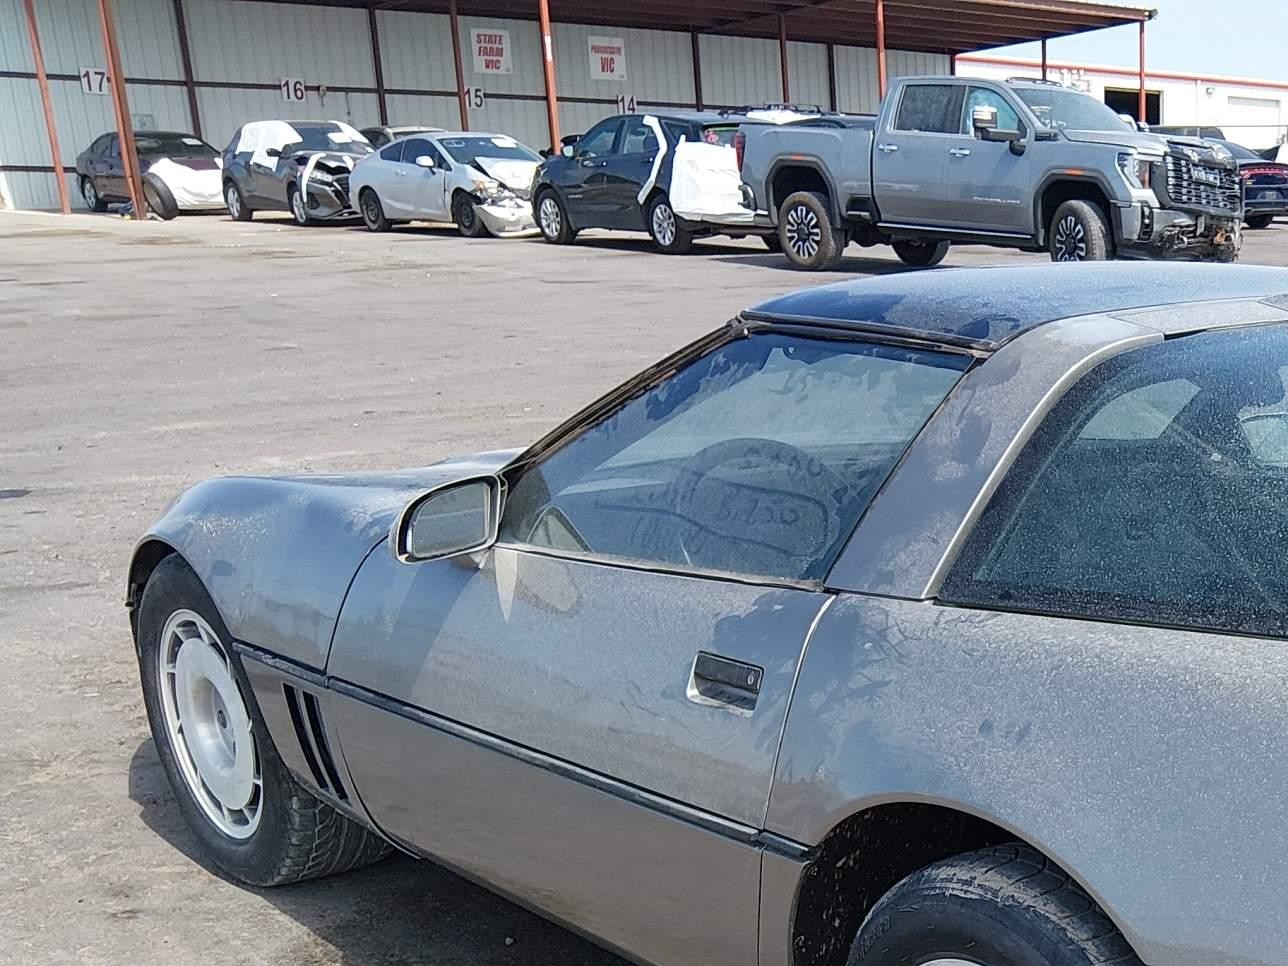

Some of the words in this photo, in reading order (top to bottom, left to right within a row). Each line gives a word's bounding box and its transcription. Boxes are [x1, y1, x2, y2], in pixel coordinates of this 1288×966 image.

[476, 33, 504, 45] STATE
[478, 46, 504, 57] FARM
[485, 58, 501, 69] VIC
[600, 56, 615, 73] VIC
[82, 70, 106, 93] 17
[282, 79, 304, 100] 16
[464, 87, 483, 107] 15
[619, 95, 636, 115] 14
